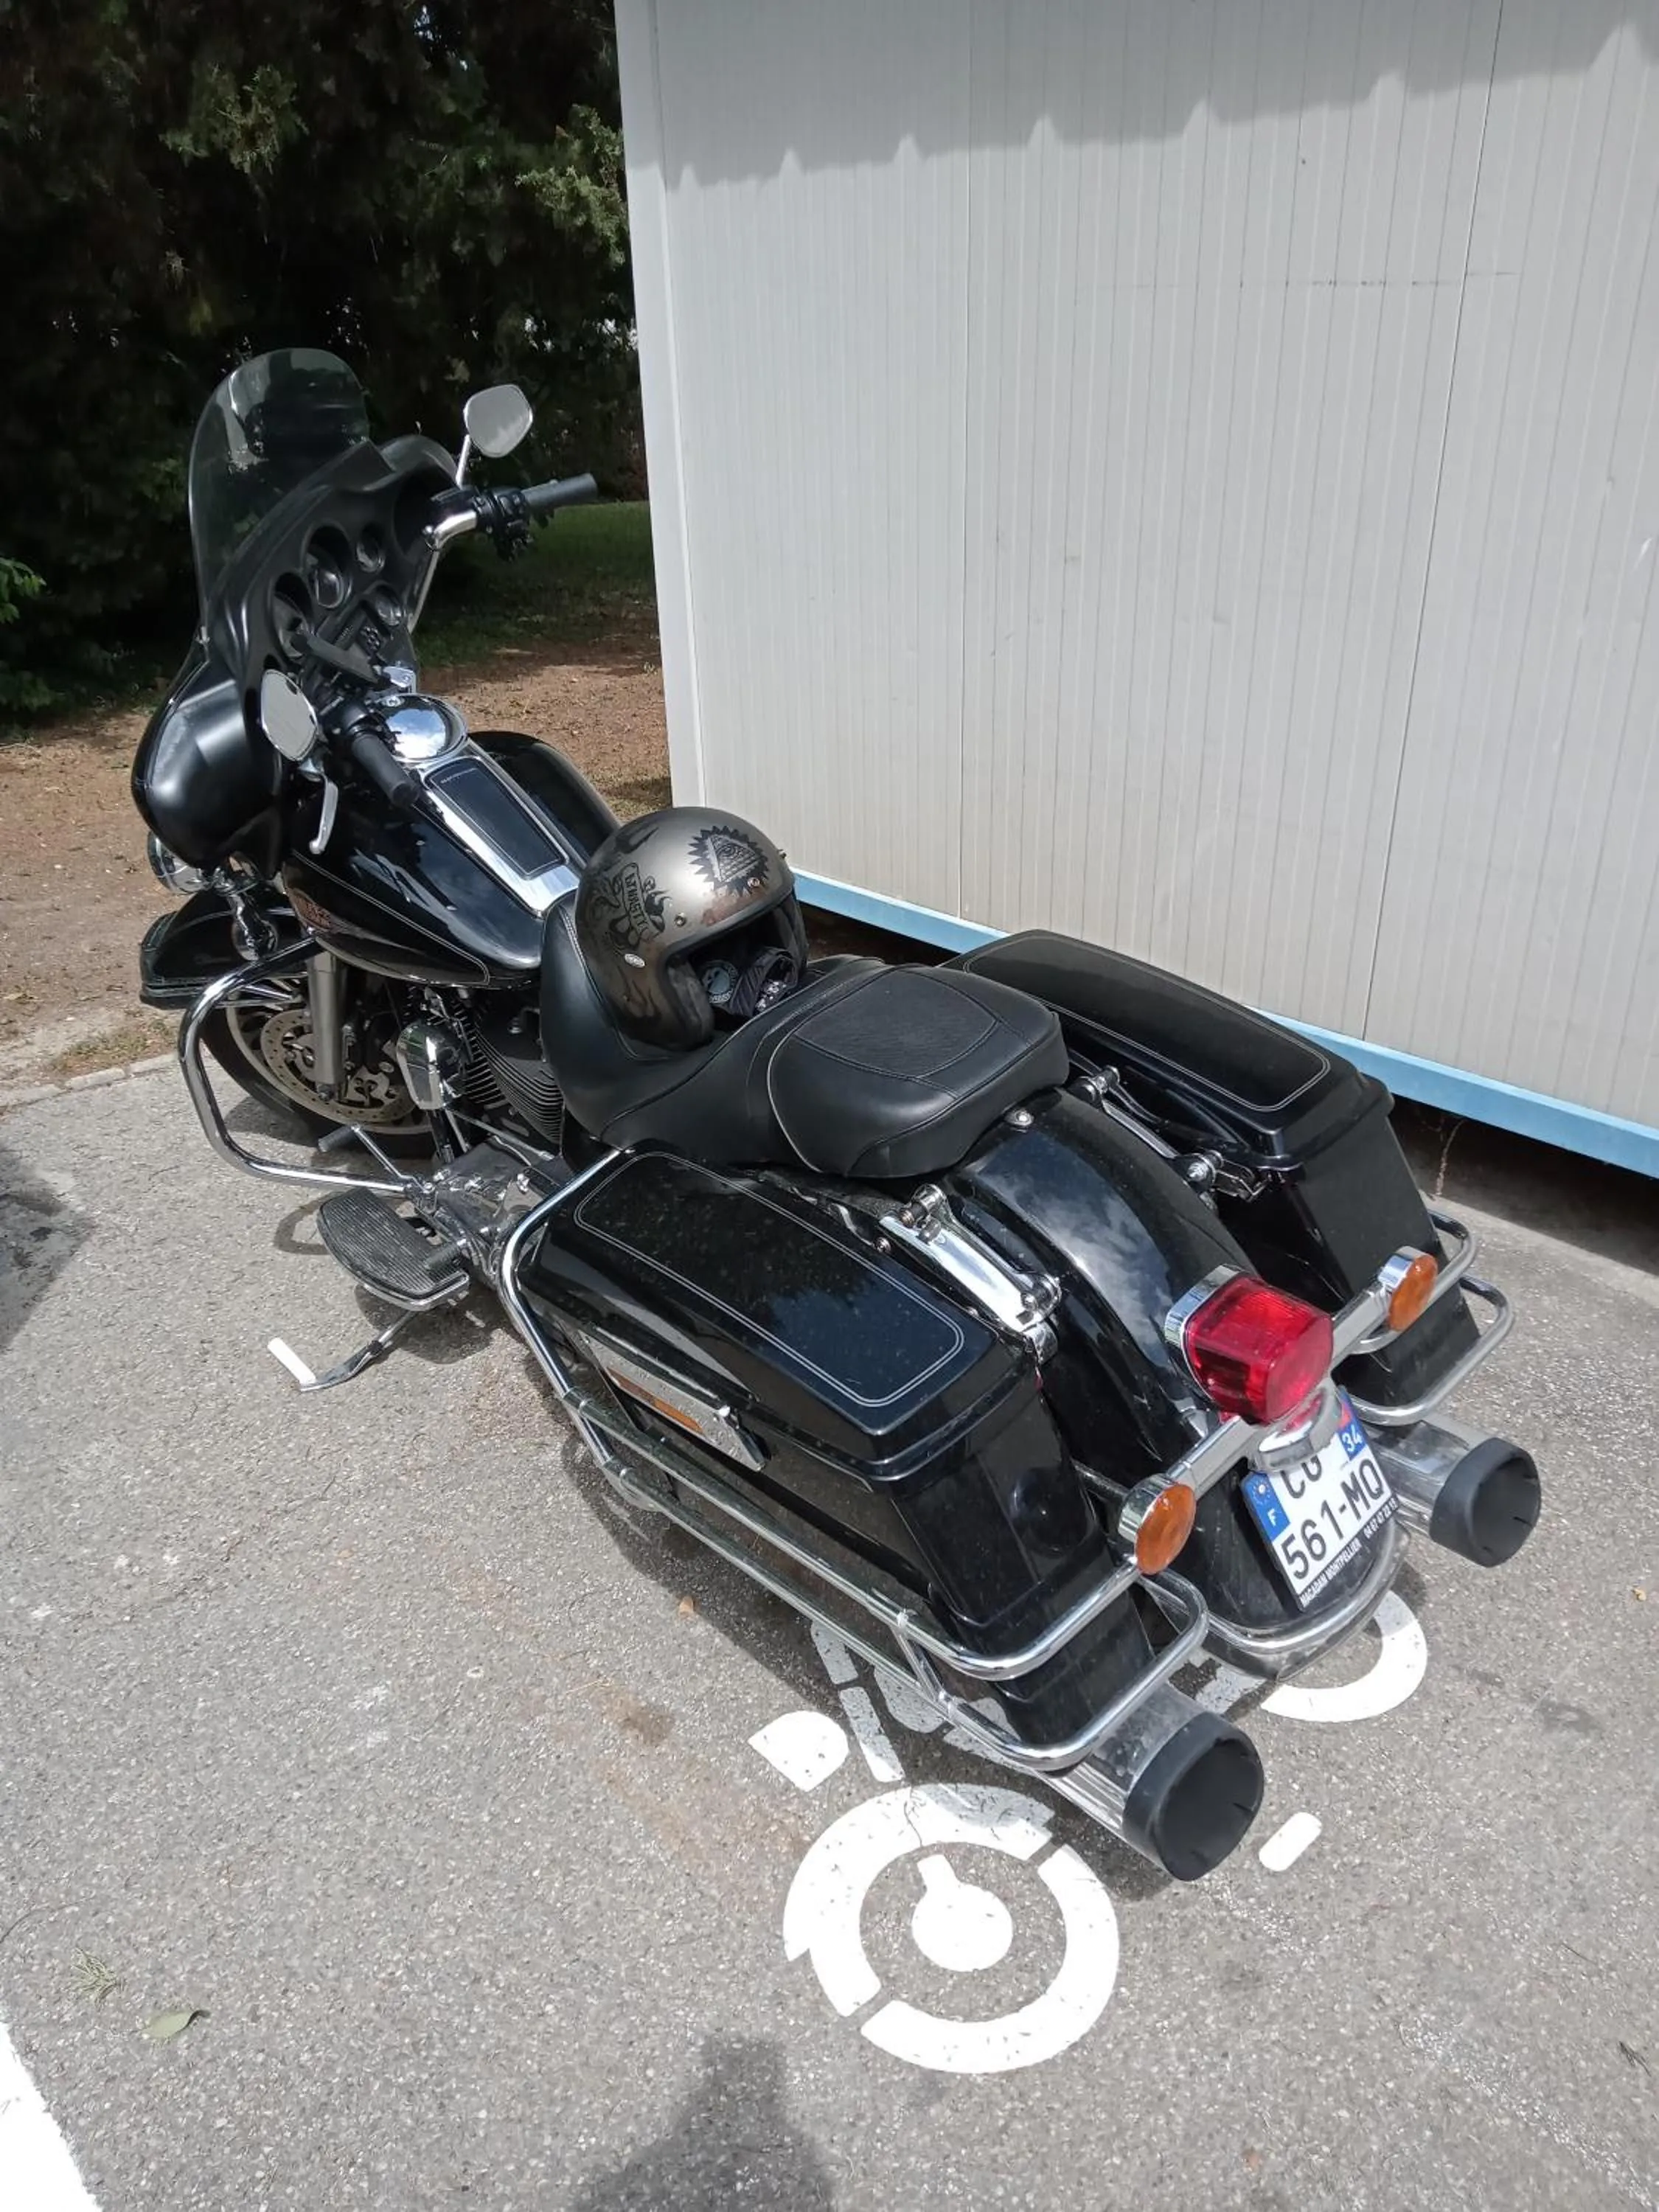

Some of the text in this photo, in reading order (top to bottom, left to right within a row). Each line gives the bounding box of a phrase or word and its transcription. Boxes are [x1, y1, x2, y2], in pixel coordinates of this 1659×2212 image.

[1341, 1424, 1363, 1453] 34
[1267, 1509, 1277, 1527] F
[1280, 1458, 1384, 1580] 561-MQ
[1324, 1537, 1363, 1581] MONTPELLIER
